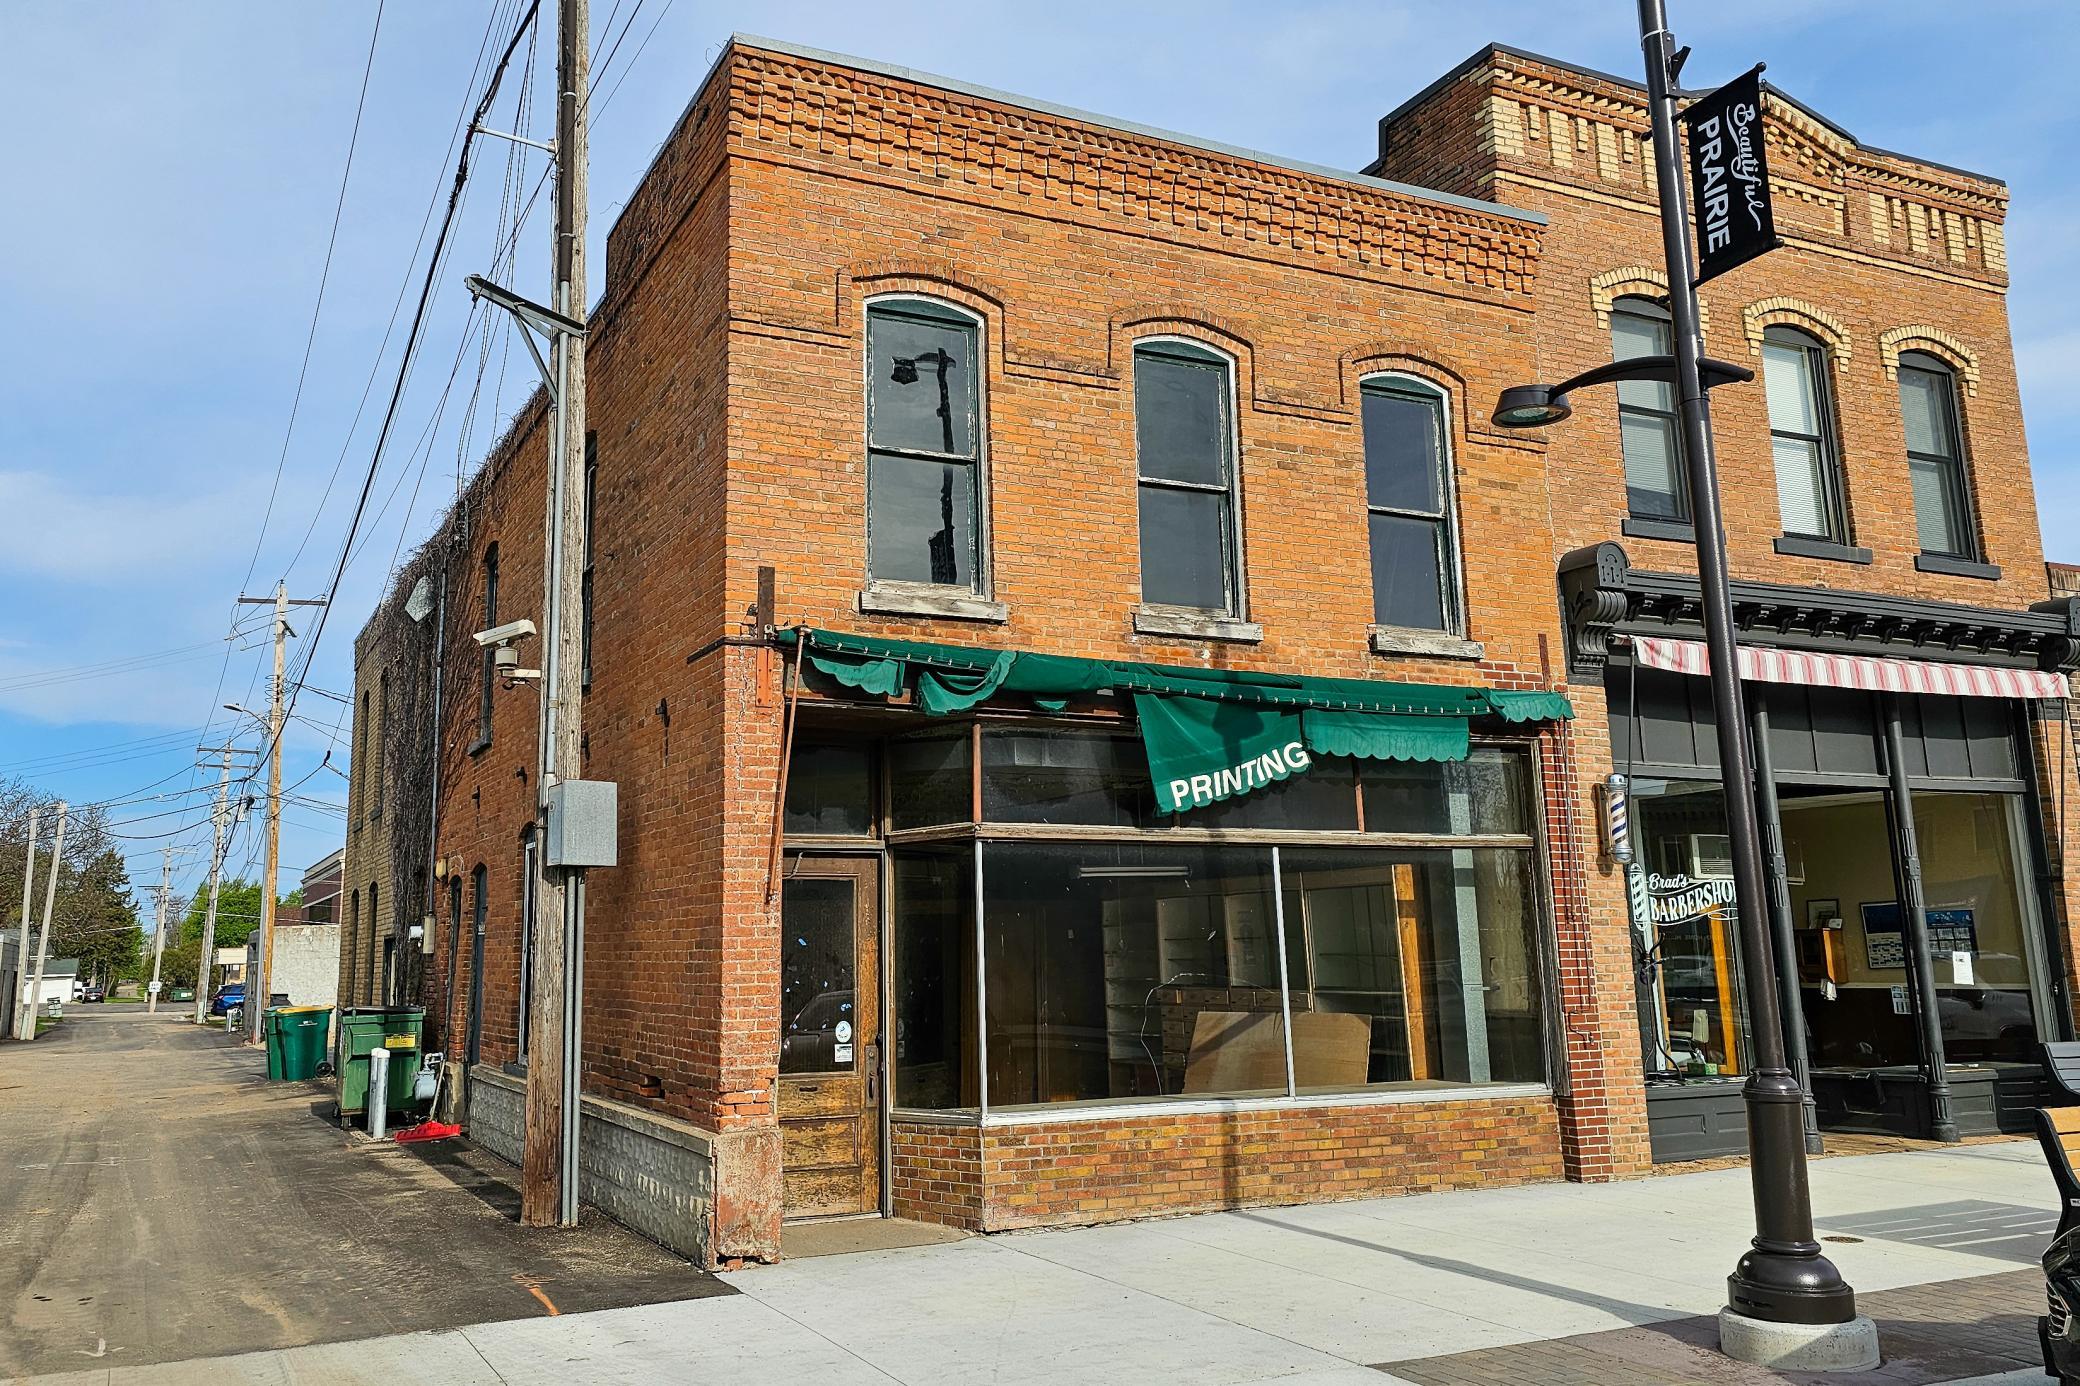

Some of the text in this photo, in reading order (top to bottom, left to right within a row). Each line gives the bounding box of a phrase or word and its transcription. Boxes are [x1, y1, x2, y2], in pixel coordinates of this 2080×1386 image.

[1697, 115, 1731, 253] PRAIRIE
[1727, 103, 1765, 232] Beautiful
[1169, 741, 1311, 808] PRINTING
[1649, 873, 1689, 890] Brad's
[1650, 879, 1737, 922] BARBERSHO
